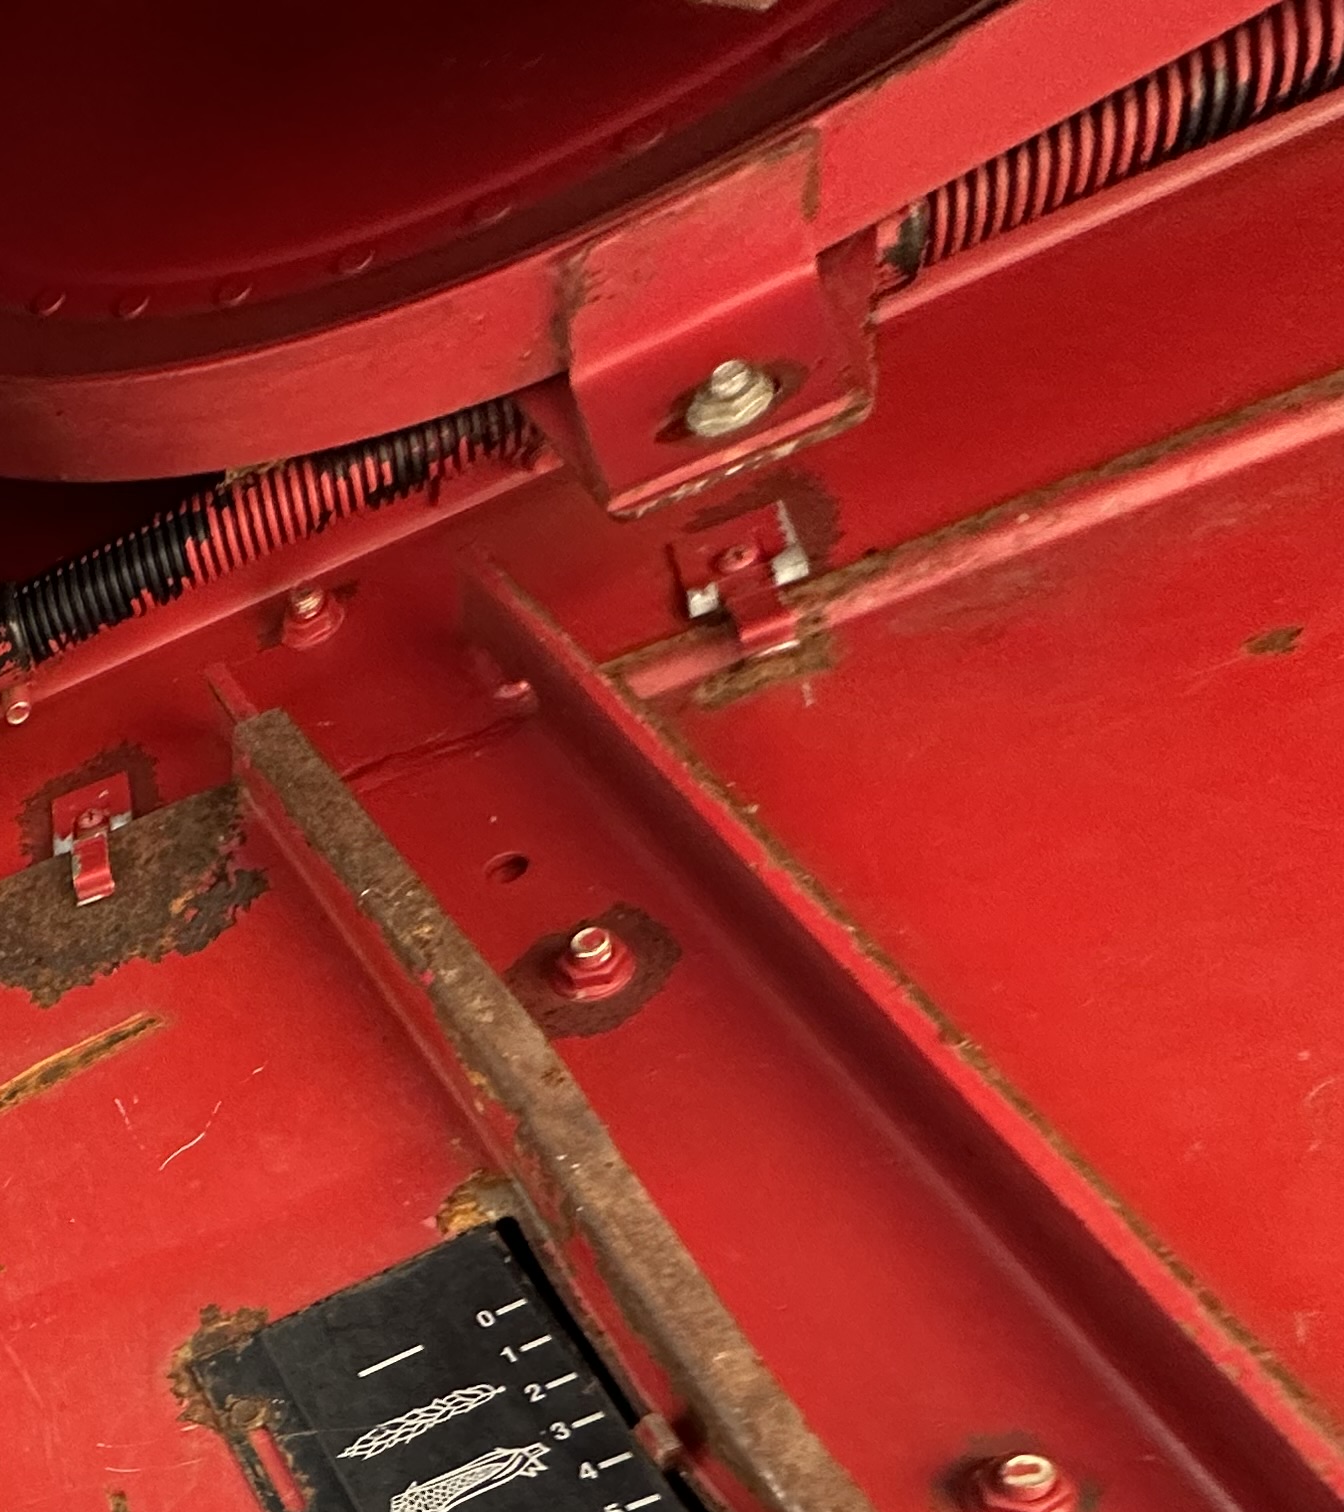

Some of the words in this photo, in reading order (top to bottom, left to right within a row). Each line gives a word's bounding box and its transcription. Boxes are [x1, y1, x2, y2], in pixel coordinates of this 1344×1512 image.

[476, 1310, 496, 1328] 0
[499, 1345, 518, 1363] 1
[523, 1383, 547, 1403] 2
[549, 1421, 571, 1441] 3
[579, 1461, 599, 1481] 4
